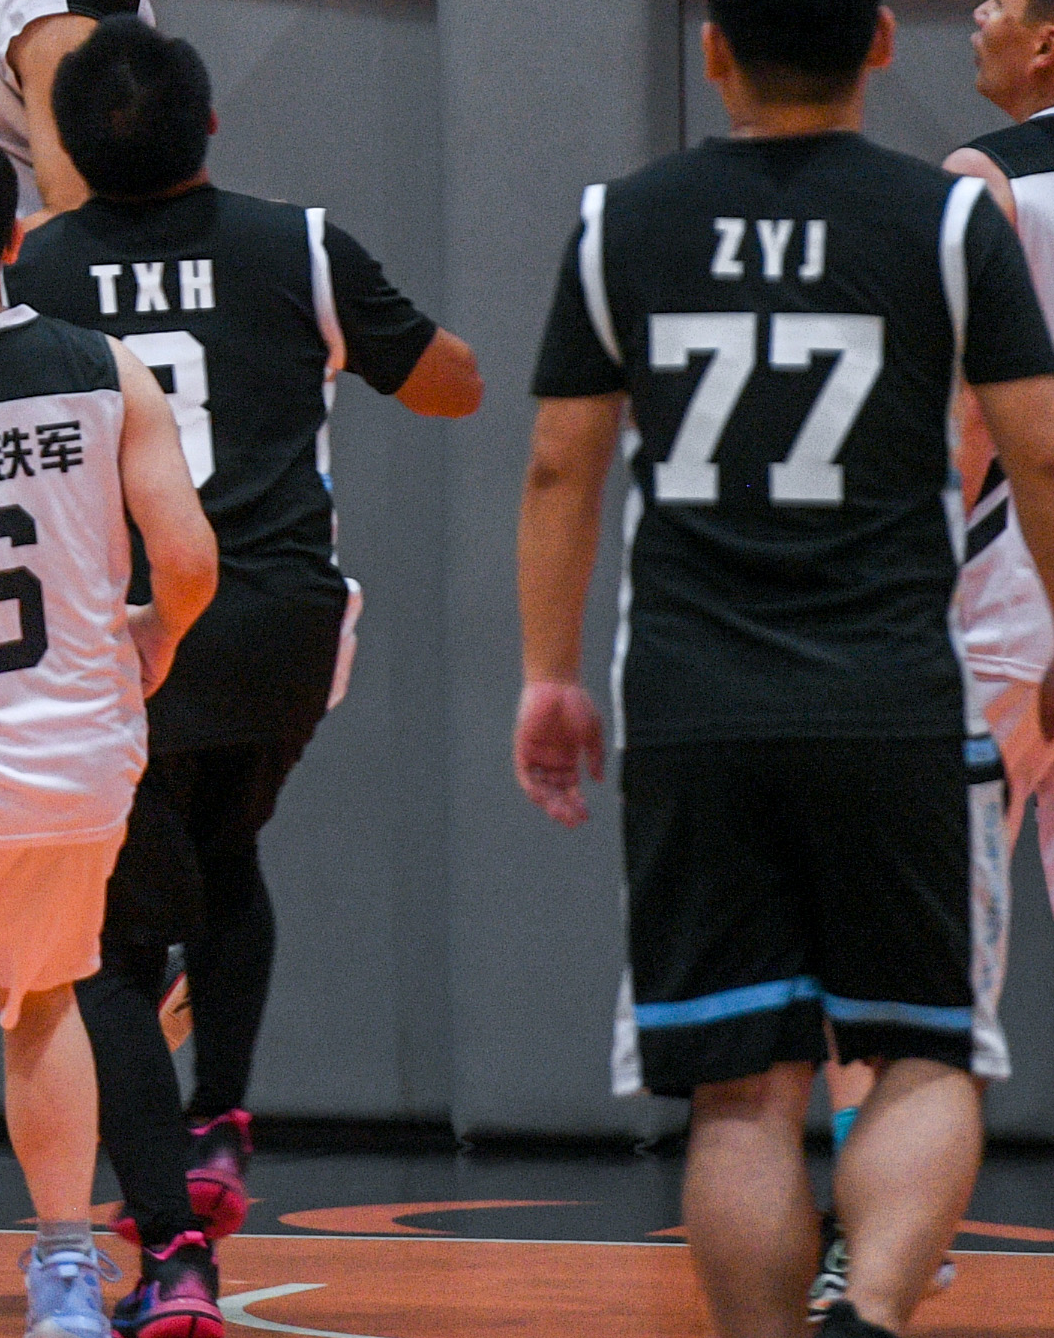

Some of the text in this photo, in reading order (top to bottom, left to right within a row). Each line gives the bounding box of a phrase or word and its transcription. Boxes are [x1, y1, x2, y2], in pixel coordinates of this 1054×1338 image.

[710, 216, 828, 282] ZYJ
[89, 259, 216, 315] TXH
[649, 311, 886, 507] 77
